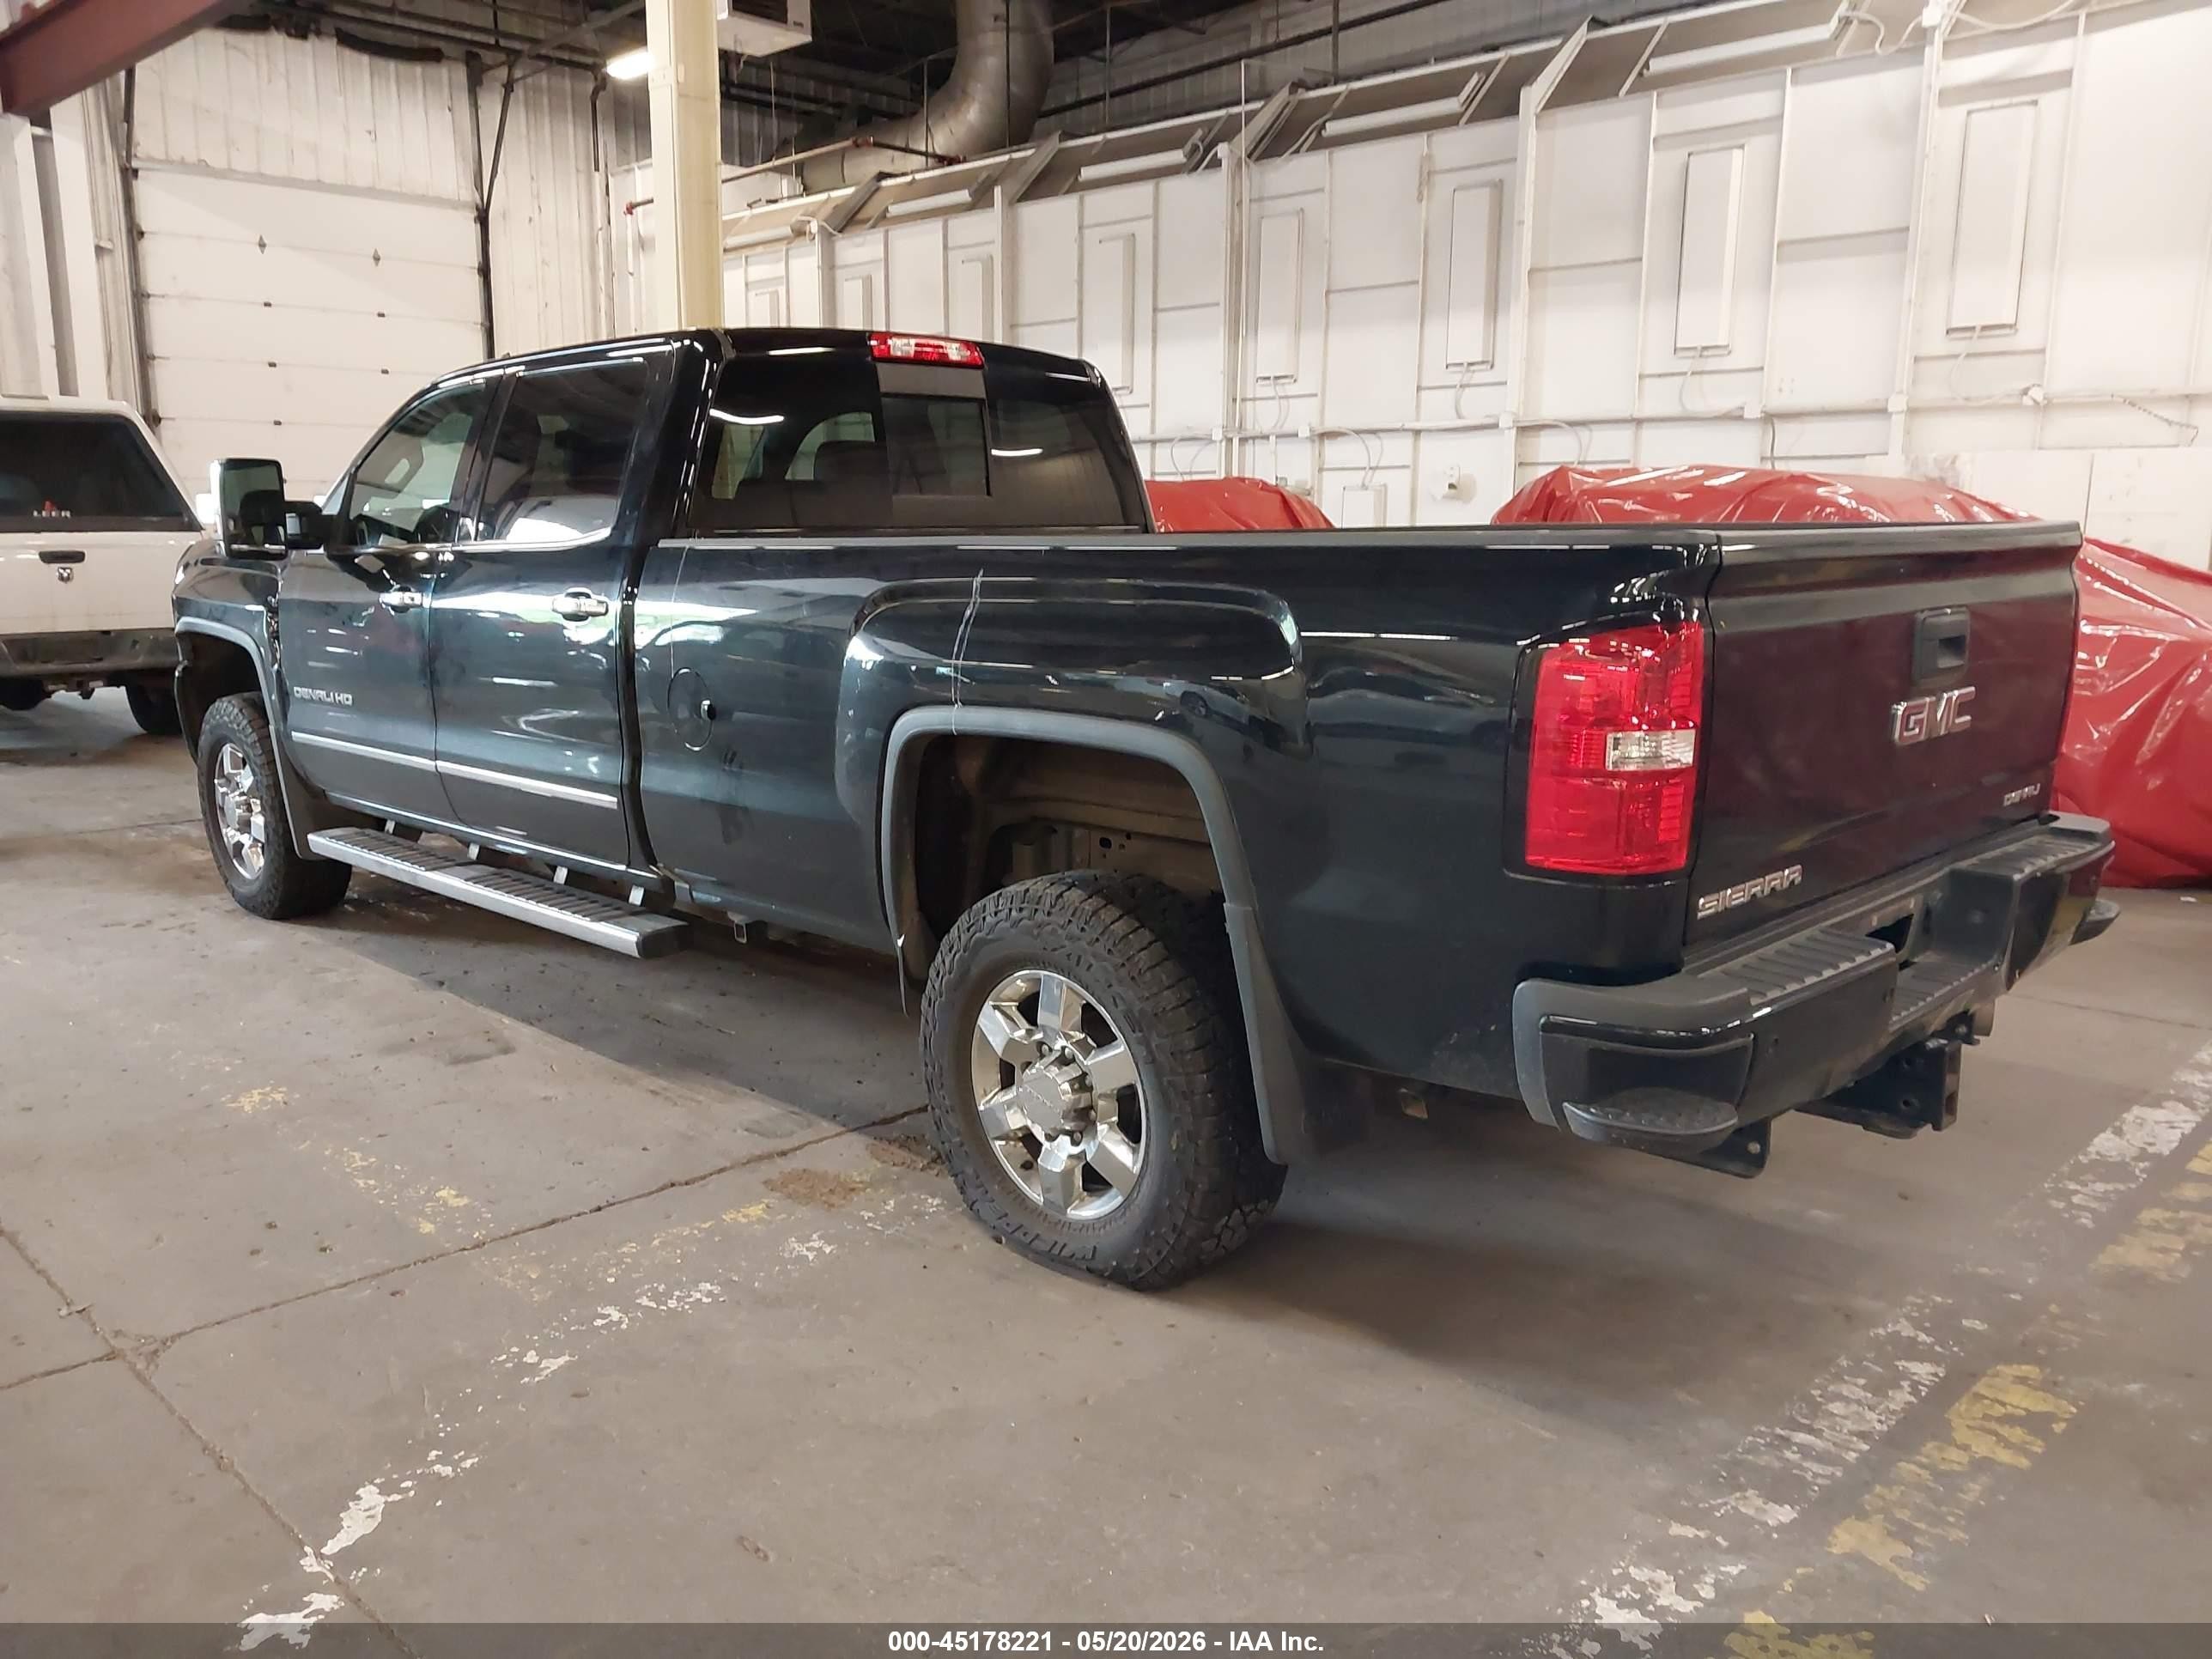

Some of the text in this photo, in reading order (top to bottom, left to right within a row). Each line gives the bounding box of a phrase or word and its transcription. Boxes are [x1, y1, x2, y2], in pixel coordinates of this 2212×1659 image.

[293, 686, 353, 707] DENALI HD
[1891, 686, 1976, 745] GMC
[1697, 864, 1802, 921] SIERRA
